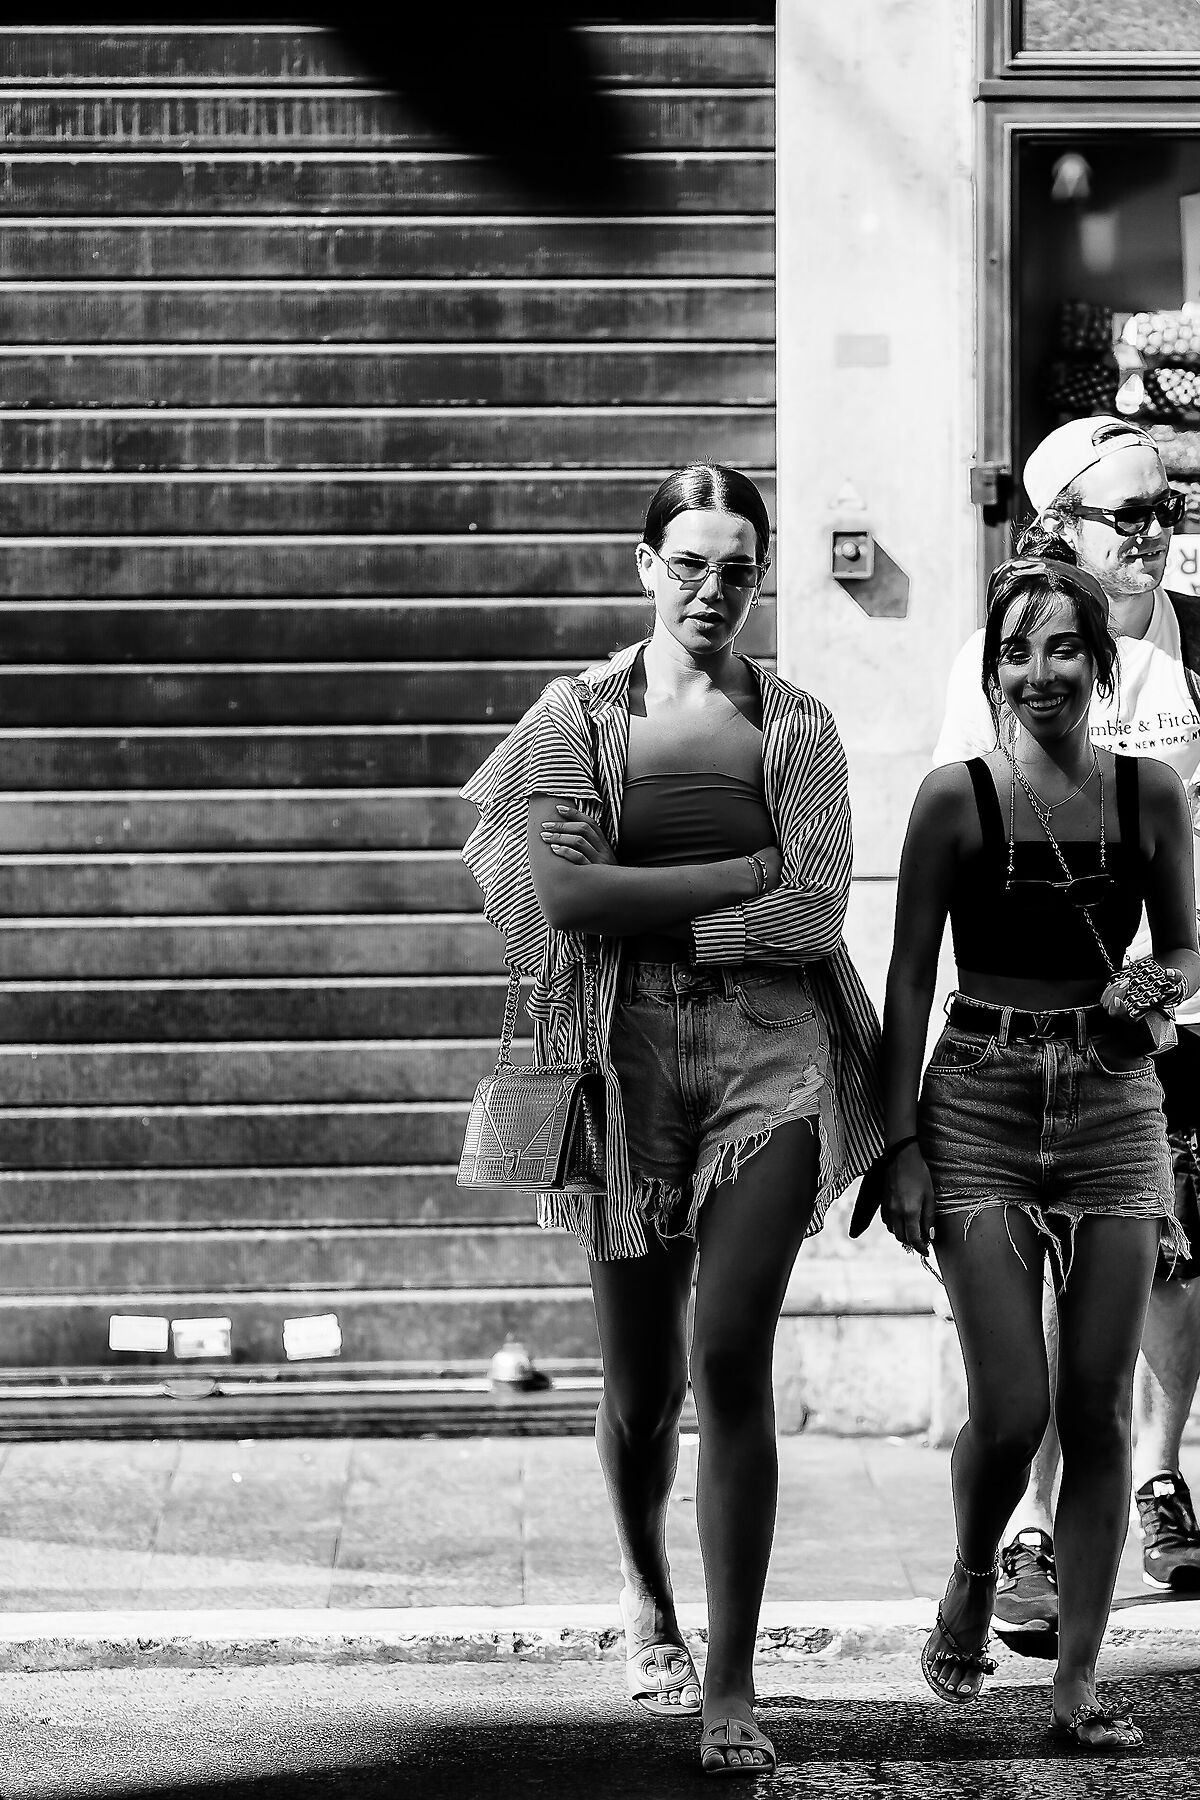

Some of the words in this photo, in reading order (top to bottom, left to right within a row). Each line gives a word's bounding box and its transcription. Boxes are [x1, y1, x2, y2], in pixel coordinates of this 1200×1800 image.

[1138, 720, 1150, 733] &
[1157, 709, 1200, 729] Fitch
[1135, 740, 1156, 750] NEW
